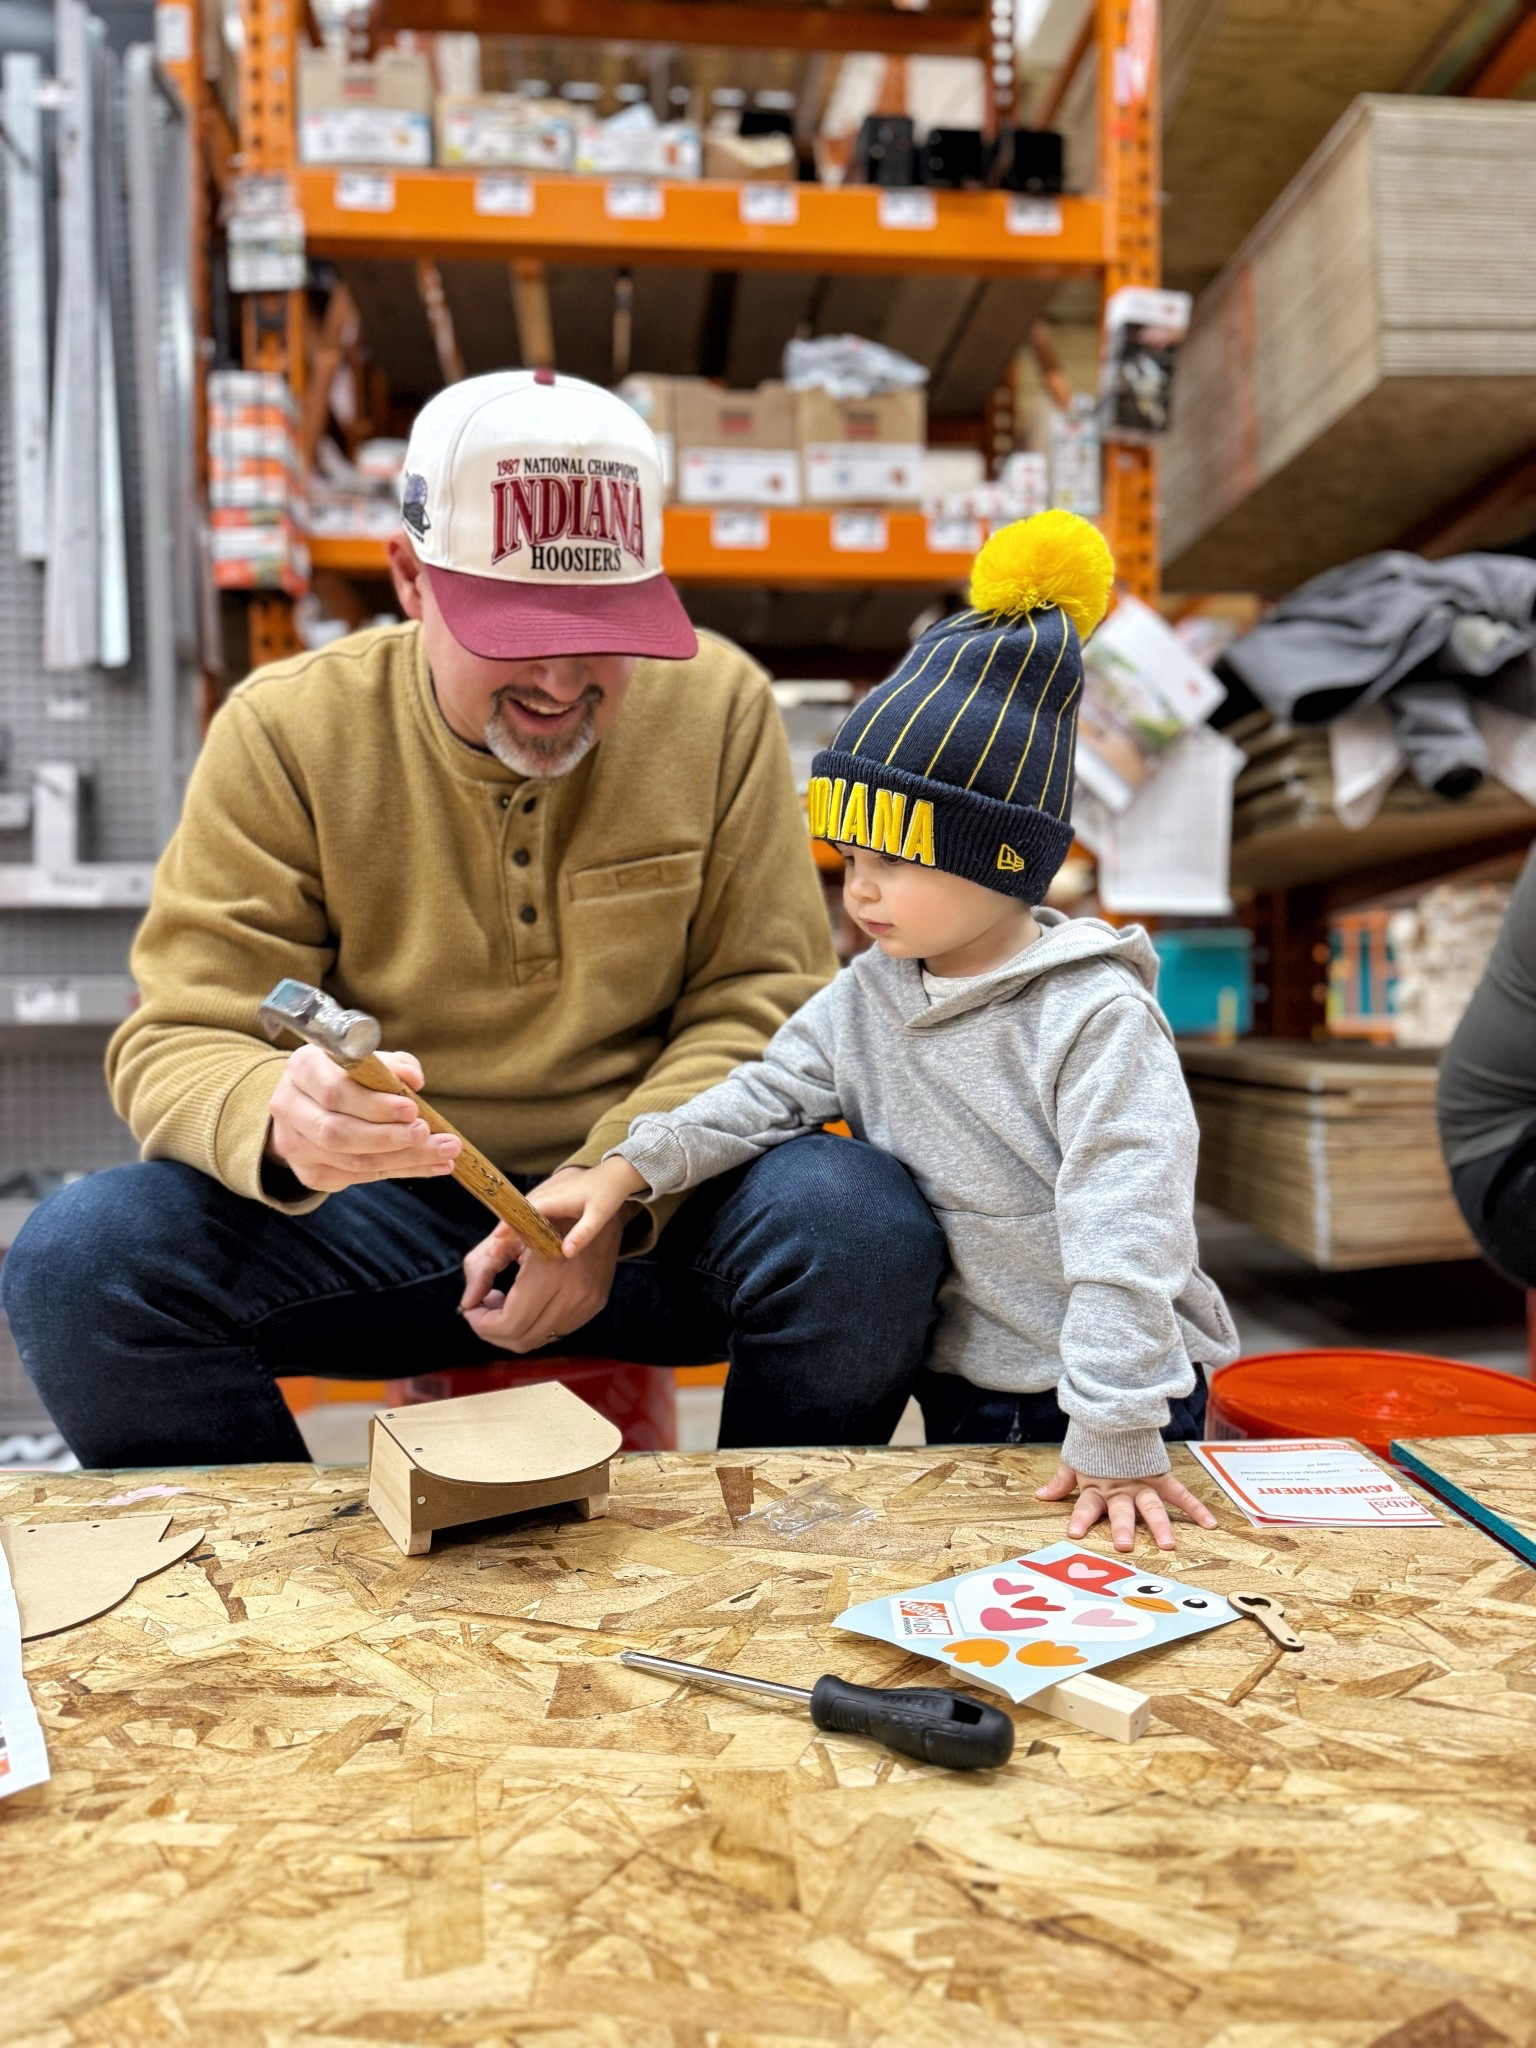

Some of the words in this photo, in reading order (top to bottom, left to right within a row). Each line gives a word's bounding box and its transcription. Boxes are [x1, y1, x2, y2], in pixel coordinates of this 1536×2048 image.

[497, 459, 520, 476] 1987
[524, 457, 584, 475] NATIONAL
[588, 459, 639, 482] CHAMPIONS
[491, 475, 645, 568] INDIANA
[531, 546, 622, 572] HOOSIERS
[808, 776, 936, 867] DIANA
[1257, 1484, 1394, 1495] ACHIEVEMENT
[1373, 1500, 1420, 1508] KIDS
[913, 1617, 932, 1633] KIDS
